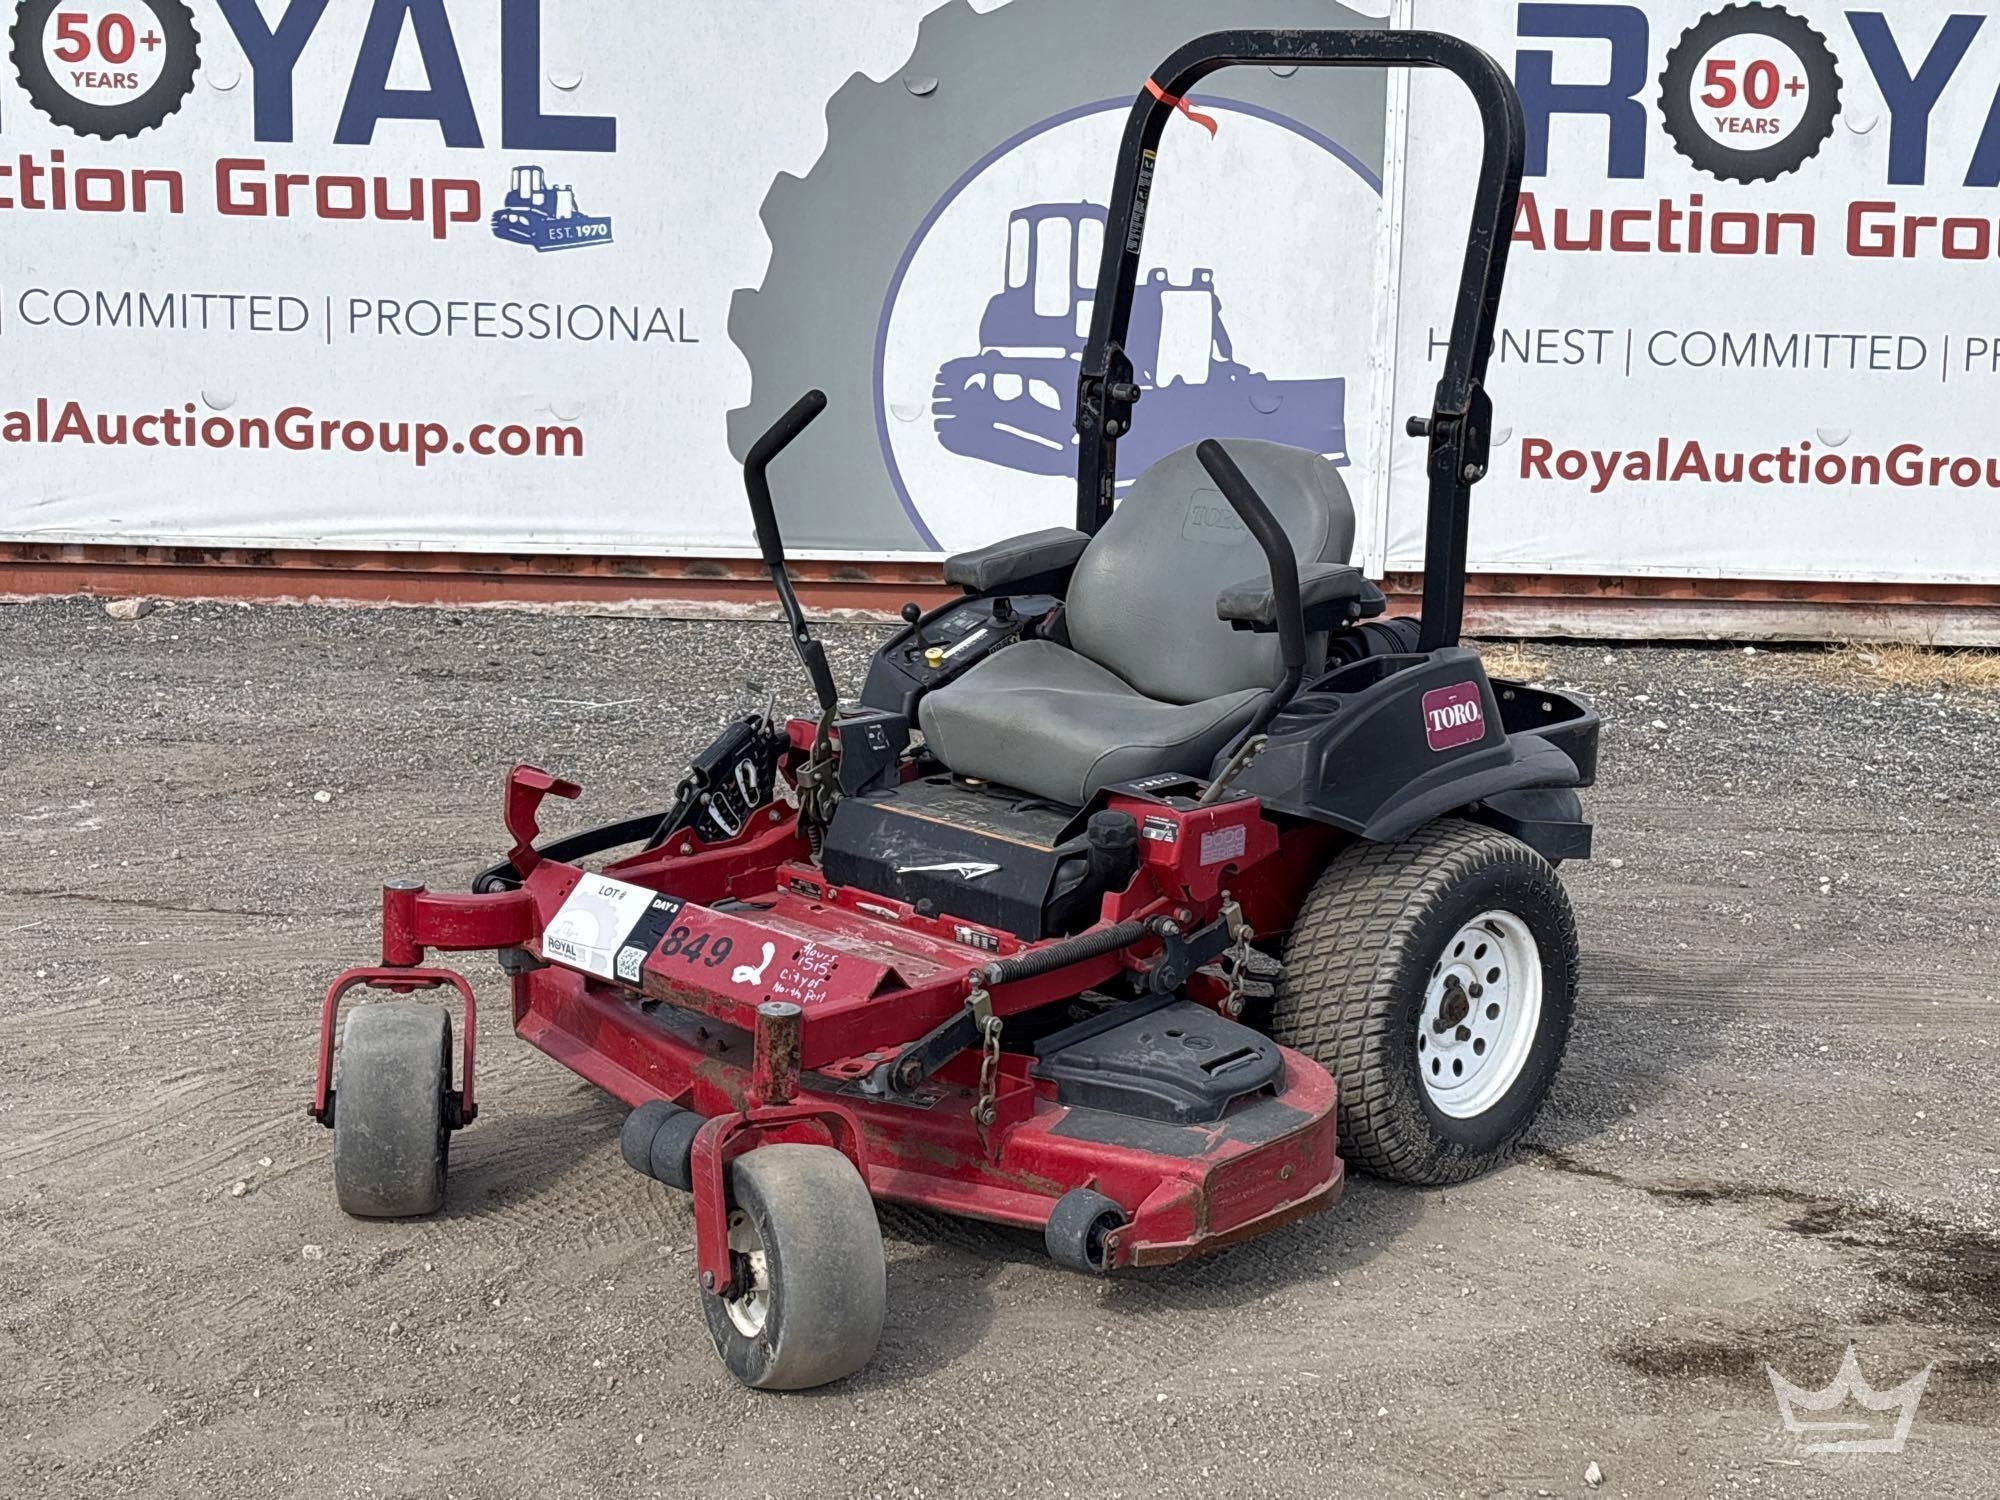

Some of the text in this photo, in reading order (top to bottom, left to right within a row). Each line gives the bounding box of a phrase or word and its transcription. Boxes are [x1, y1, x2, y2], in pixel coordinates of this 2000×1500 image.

[53, 13, 162, 64] 50+
[70, 71, 139, 89] YEARS
[1516, 2, 2000, 188] ROY
[1700, 59, 1806, 109] 50+
[1714, 117, 1780, 135] YEARS
[215, 157, 480, 239] Group
[549, 224, 608, 240] EST. 1970
[1511, 192, 2000, 259] Auction Gro
[19, 288, 700, 344] COMMITTED PROFESSIONAL
[1427, 327, 1614, 365] HNEST
[1647, 331, 1927, 371] COMMITTED
[2, 397, 584, 466] alAuctionGroup.com
[1428, 700, 1479, 731] TORO
[598, 885, 619, 898] LOT
[652, 899, 679, 913] DAY 3
[548, 936, 577, 956] ROYAL
[661, 926, 733, 967] 849
[800, 941, 839, 962] Hours
[772, 980, 801, 999] North
